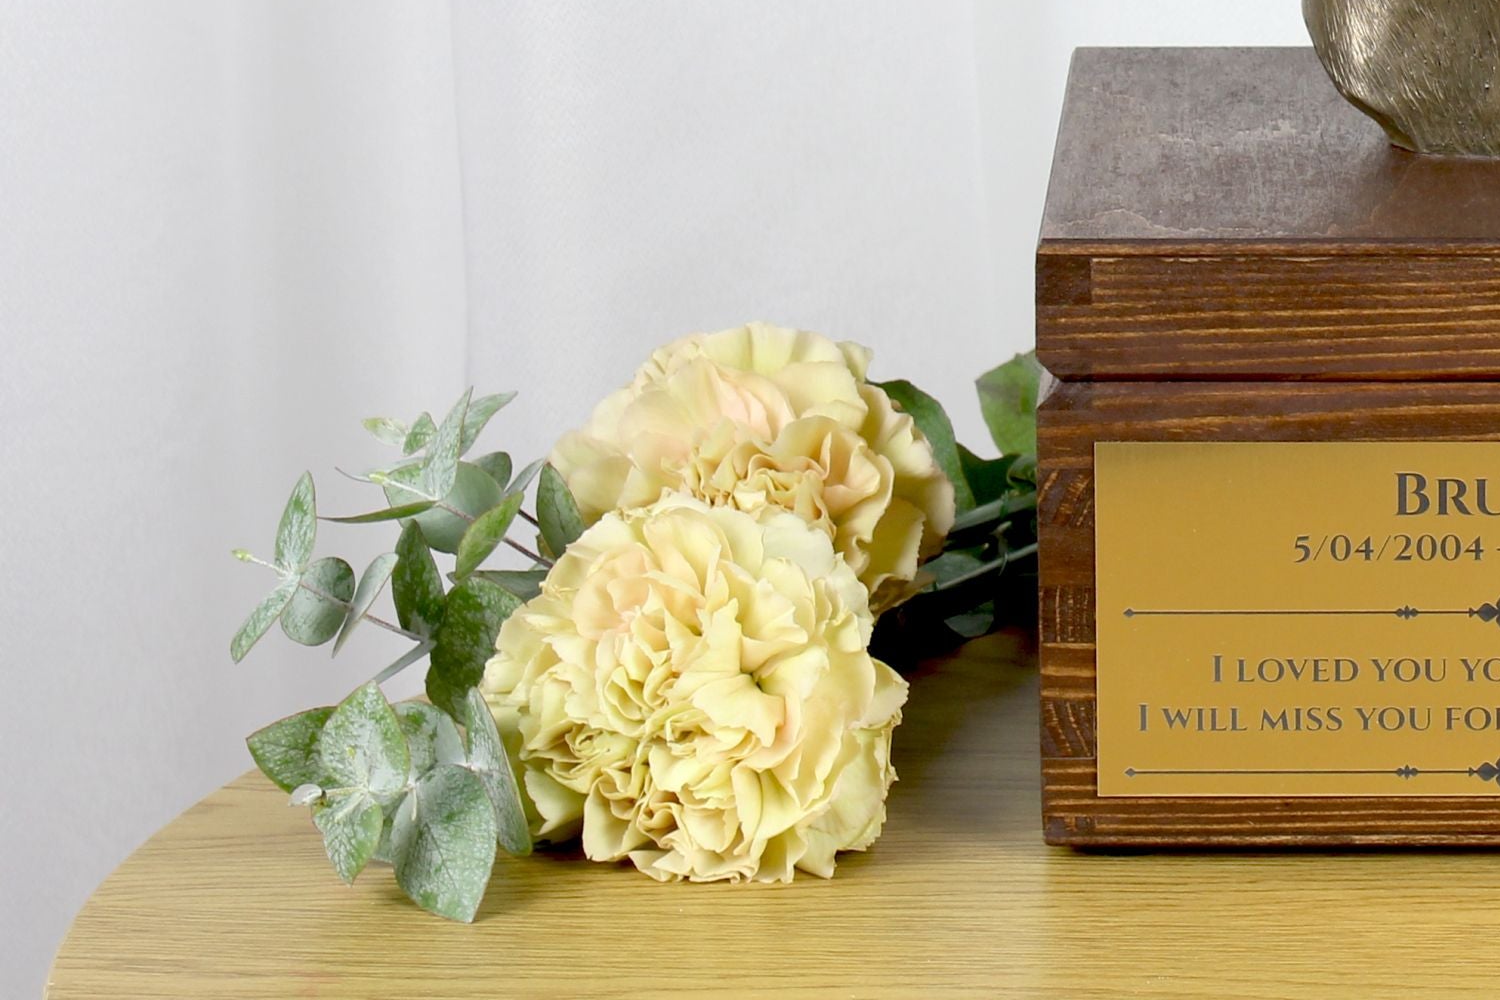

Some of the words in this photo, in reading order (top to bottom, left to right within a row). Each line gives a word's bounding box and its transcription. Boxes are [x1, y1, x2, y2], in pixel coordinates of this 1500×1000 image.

[1293, 533, 1486, 563] 5/04/2004
[1211, 654, 1223, 683] I
[1237, 657, 1360, 684] LOVED
[1370, 657, 1447, 684] YOU
[1137, 703, 1149, 732] I
[1161, 707, 1249, 733] WILL
[1259, 706, 1344, 732] MISS
[1354, 706, 1432, 732] YOU
